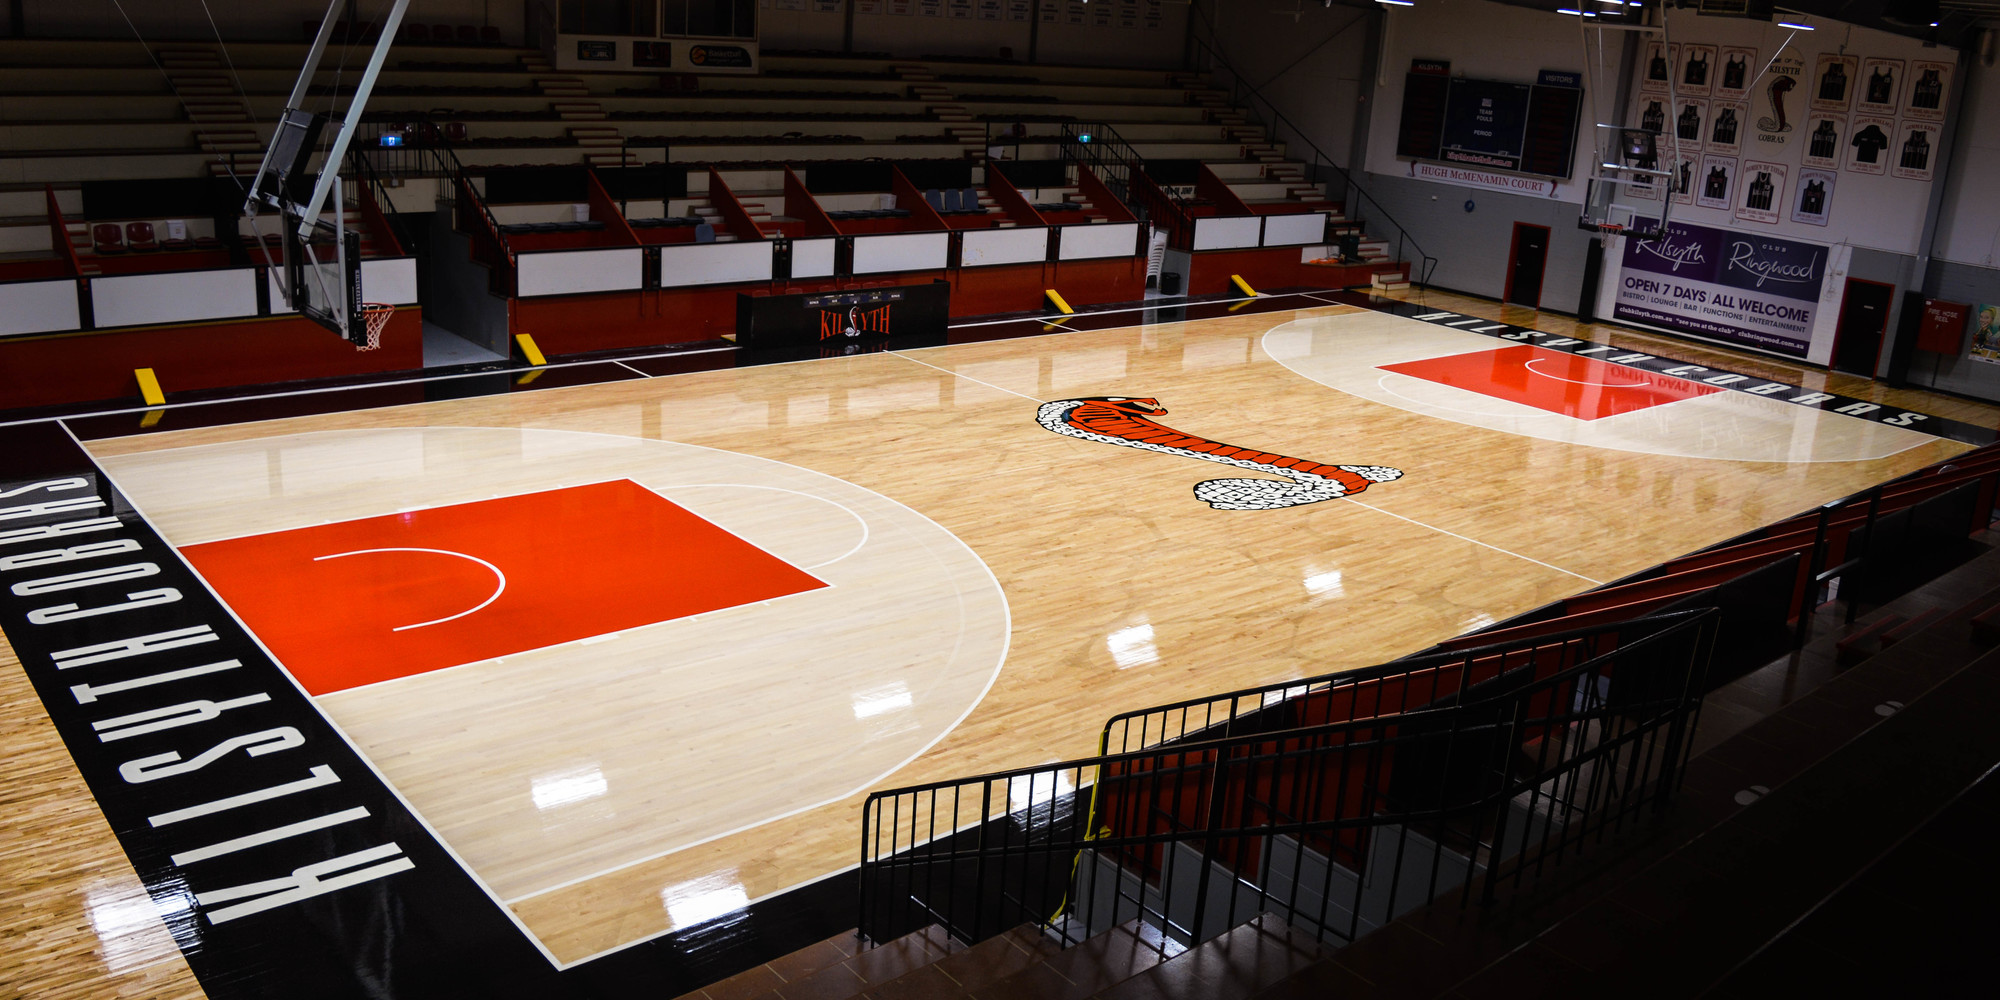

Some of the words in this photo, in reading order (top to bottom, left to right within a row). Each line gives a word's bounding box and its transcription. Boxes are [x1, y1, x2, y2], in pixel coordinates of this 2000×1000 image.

[1418, 64, 1442, 72] KILSYTH
[1544, 74, 1574, 84] VISITORS
[1769, 66, 1800, 75] KILSYTH
[1758, 134, 1785, 144] COBRAS
[1421, 166, 1448, 178] HUGH
[1450, 168, 1508, 187] McMENAMIN
[1511, 179, 1544, 192] COURT
[1635, 226, 1706, 272] Kilsyth
[1664, 228, 1688, 236] CLUB
[1762, 243, 1788, 252] CLUB
[1728, 240, 1818, 288] Ringwood
[1622, 290, 1646, 301] BISTRO
[1650, 296, 1678, 308] LOUNGE
[1683, 303, 1698, 312] BAR
[1702, 308, 1743, 320] FUNCTIONS
[1748, 316, 1806, 333] ENTERTAINMENT
[1624, 277, 1660, 294] OPEN
[1662, 284, 1671, 296] 7
[1673, 286, 1707, 303] DAYS
[1712, 294, 1736, 311] ALL
[1738, 298, 1810, 323] WELCOME
[1928, 308, 1940, 316] FIRE
[1942, 310, 1959, 320] HOSE
[1620, 306, 1673, 322] clubkilsyth.com.au
[1689, 320, 1700, 330] you
[1708, 323, 1718, 332] the
[1738, 330, 1804, 350] clubringwood.com.au
[1411, 312, 1656, 363] KILSYTH
[1661, 364, 1928, 427] COBRAS
[0, 476, 184, 625] COBRAS
[49, 623, 416, 926] KILSYTH
